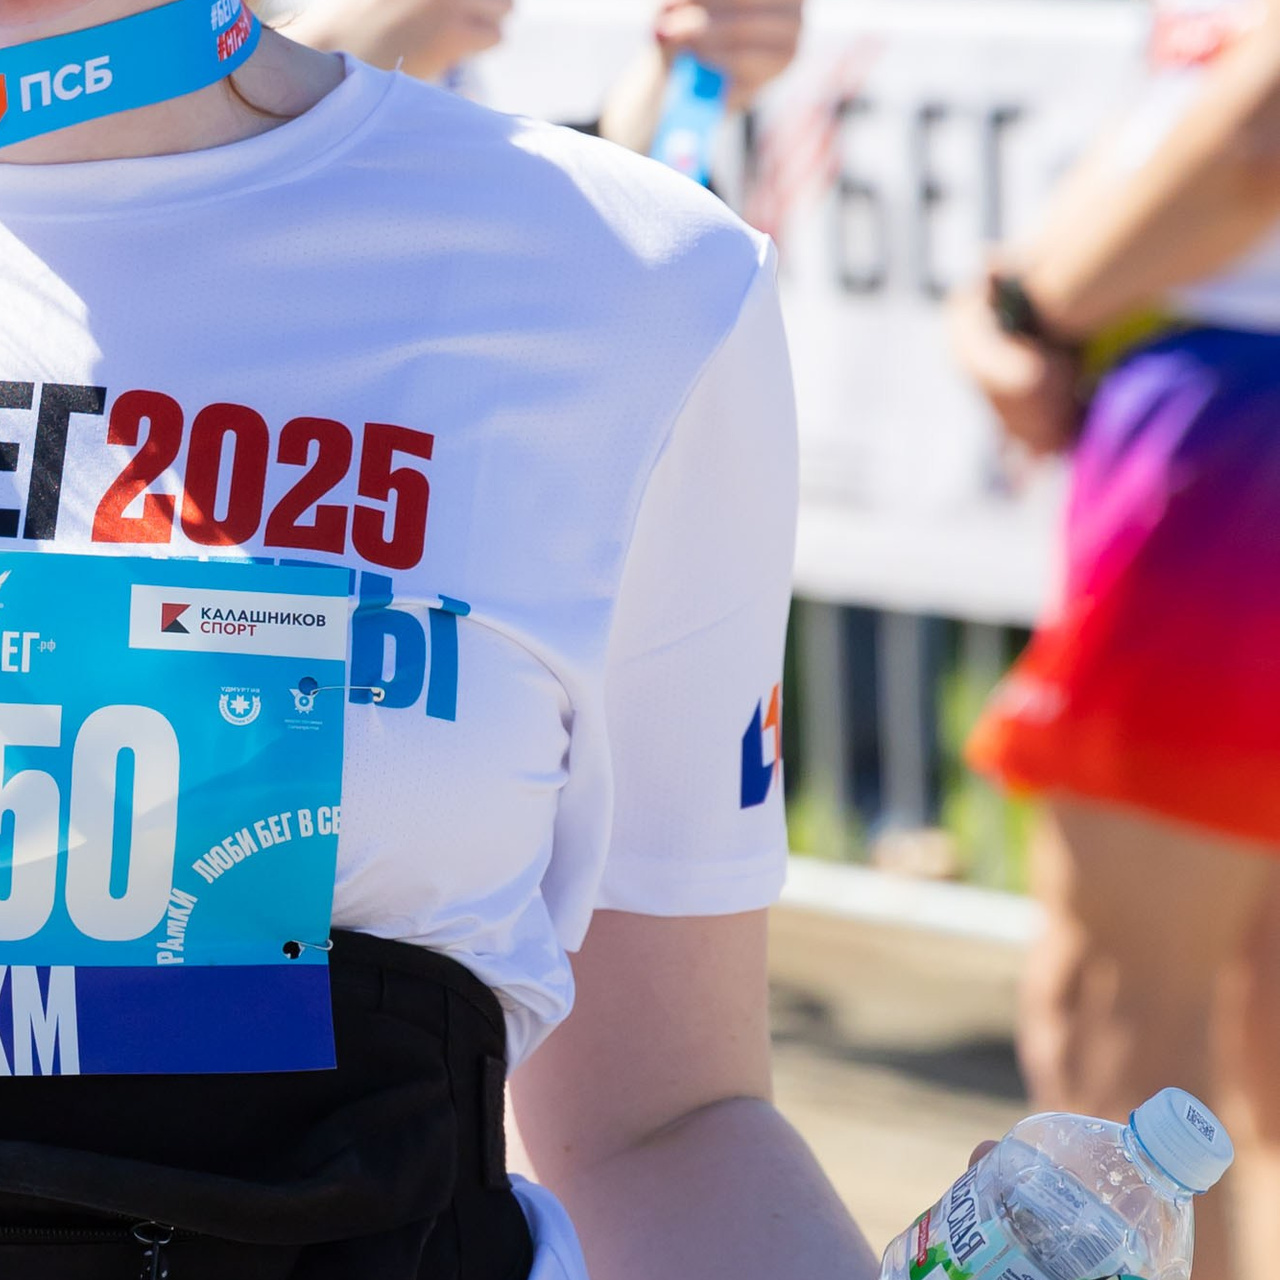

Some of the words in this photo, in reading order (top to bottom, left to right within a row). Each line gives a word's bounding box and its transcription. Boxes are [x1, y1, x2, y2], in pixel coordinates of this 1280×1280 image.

[21, 55, 113, 112] ПСБ
[200, 621, 257, 637] СПОРТ
[201, 607, 326, 628] КАЛАШНИКОВ
[157, 887, 199, 965] РАМКИ
[192, 827, 259, 884] ЛЮБИ
[253, 811, 292, 849] БЕГ
[297, 808, 313, 837] В
